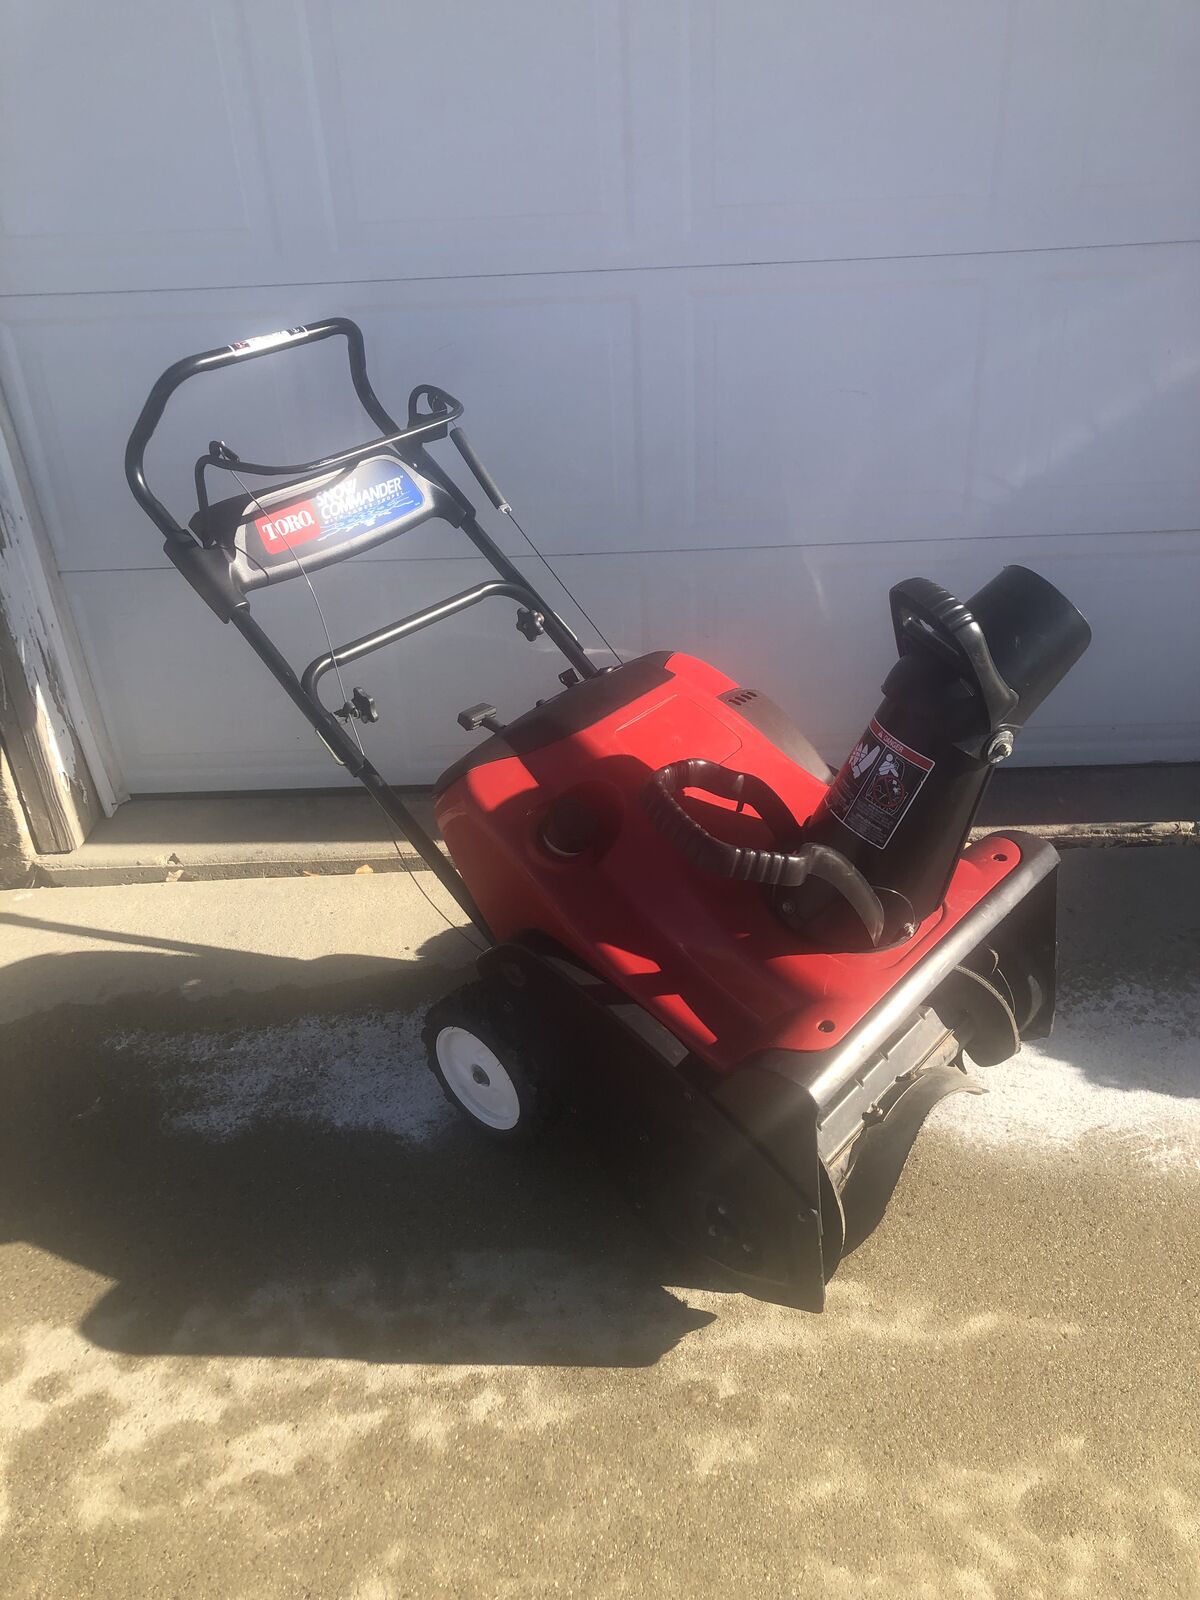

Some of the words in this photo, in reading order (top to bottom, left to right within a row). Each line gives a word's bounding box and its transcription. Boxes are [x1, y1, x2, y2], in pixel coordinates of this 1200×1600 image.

[316, 478, 357, 507] SNOW
[321, 478, 402, 520] COMMANDER
[883, 733, 904, 753] DANGER
